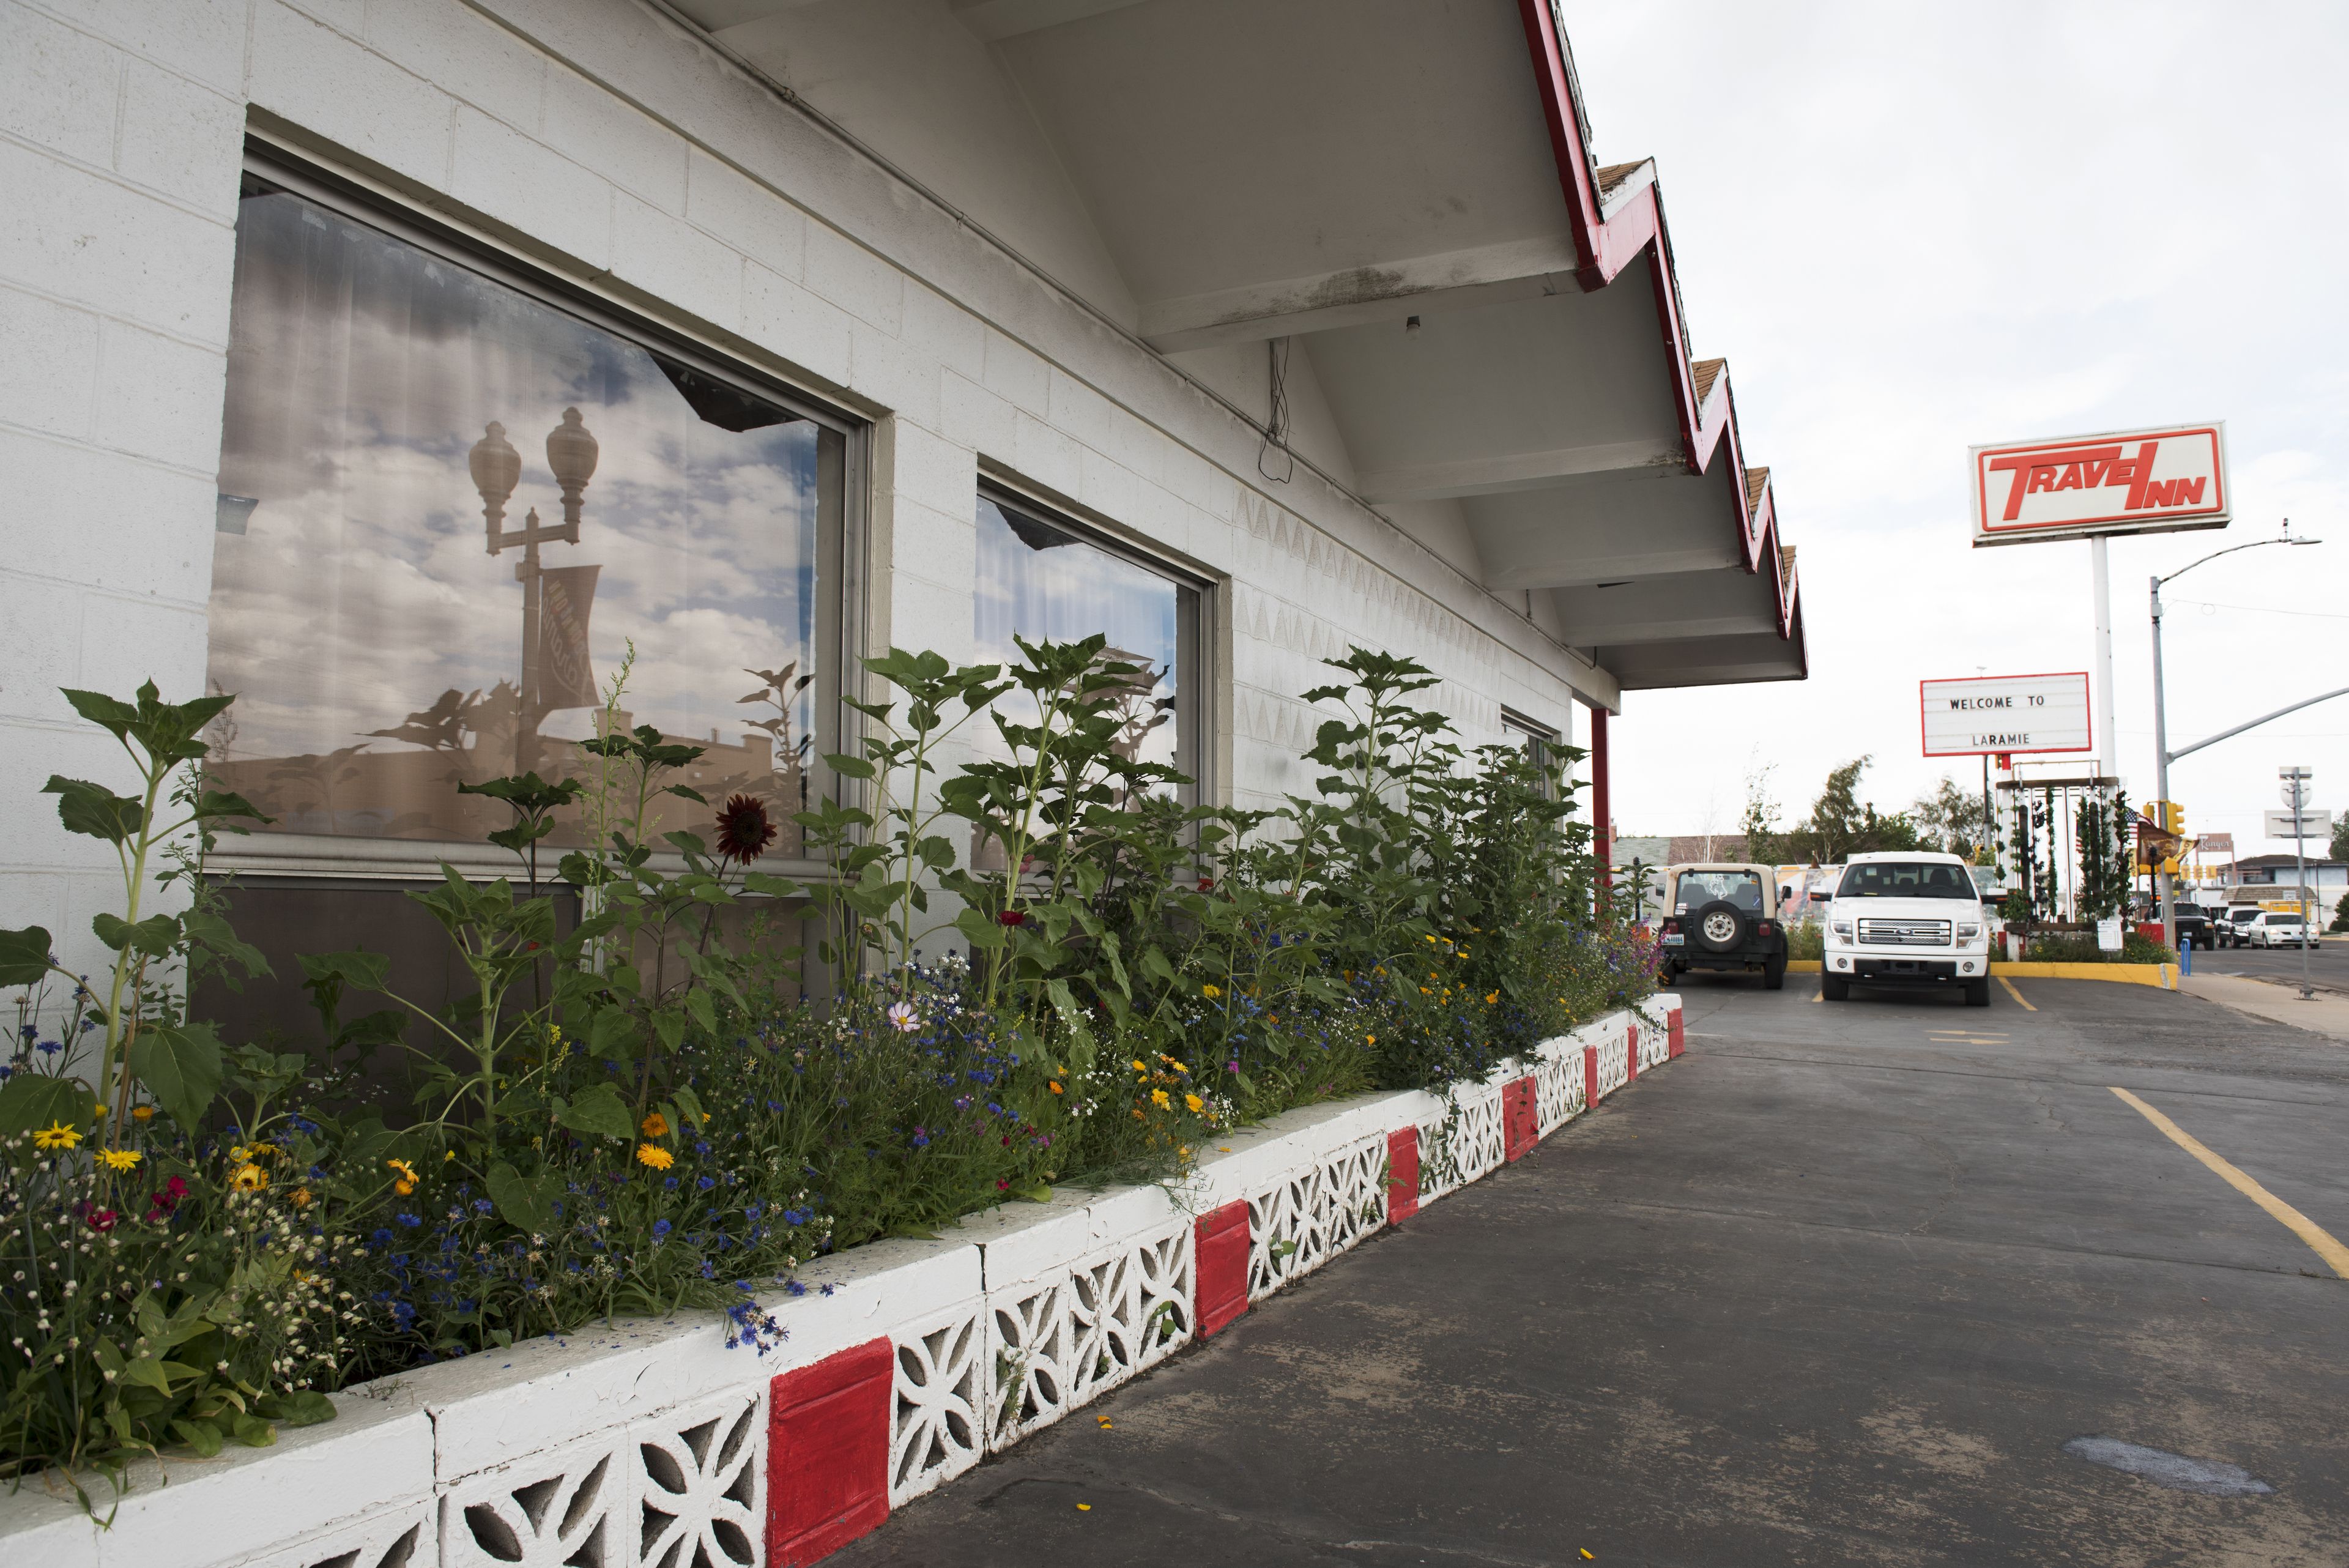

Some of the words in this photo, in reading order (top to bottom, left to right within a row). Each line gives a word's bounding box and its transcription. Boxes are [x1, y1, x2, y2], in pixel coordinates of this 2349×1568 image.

[2124, 442, 2206, 510] INN
[1950, 697, 2013, 710] WELCOME
[2028, 695, 2045, 706] TO
[1972, 733, 2030, 746] LARAMIE
[2199, 835, 2231, 850] Ranger
